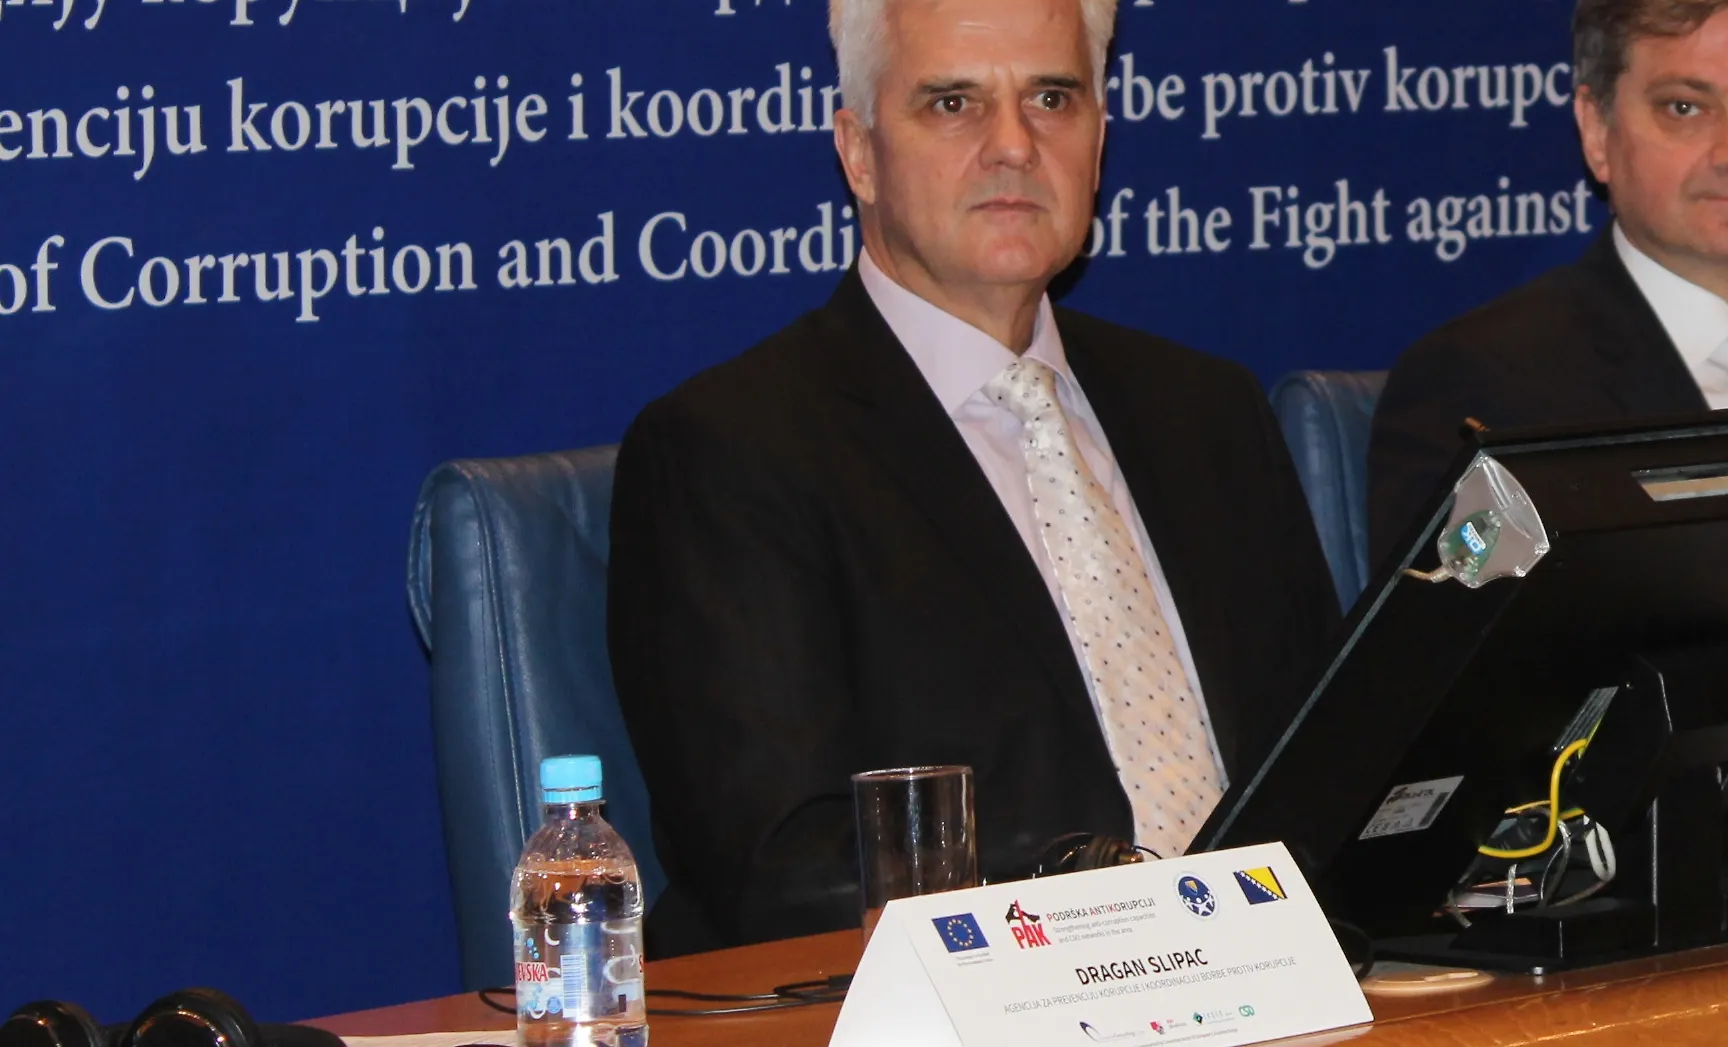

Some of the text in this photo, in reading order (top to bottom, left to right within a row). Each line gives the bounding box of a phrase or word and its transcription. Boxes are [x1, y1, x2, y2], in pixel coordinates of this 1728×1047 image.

[226, 74, 548, 170] korupcije
[568, 73, 589, 140] i
[1201, 52, 1371, 139] protiv
[0, 234, 65, 315] of
[80, 225, 478, 322] Corruption
[497, 211, 620, 288] and
[1144, 186, 1232, 255] the
[1249, 179, 1391, 268] Fight
[1407, 177, 1592, 261] against
[1046, 897, 1156, 923] PODRŠKA ANTIKORUPCIJI
[1011, 923, 1051, 949] PAK
[1004, 999, 1042, 1015] AGENCIJA
[1041, 997, 1052, 1008] ZA
[1052, 989, 1099, 1006] PREVENCIJU
[1099, 983, 1141, 998] KORUPCIJE
[1145, 974, 1201, 991] KOORDINACIJU
[1201, 968, 1227, 981] BORBE
[1227, 963, 1255, 978] PROTIV
[1254, 956, 1297, 972] KORUPCIJE
[1075, 948, 1209, 986] DRAGAN SLIPAC
